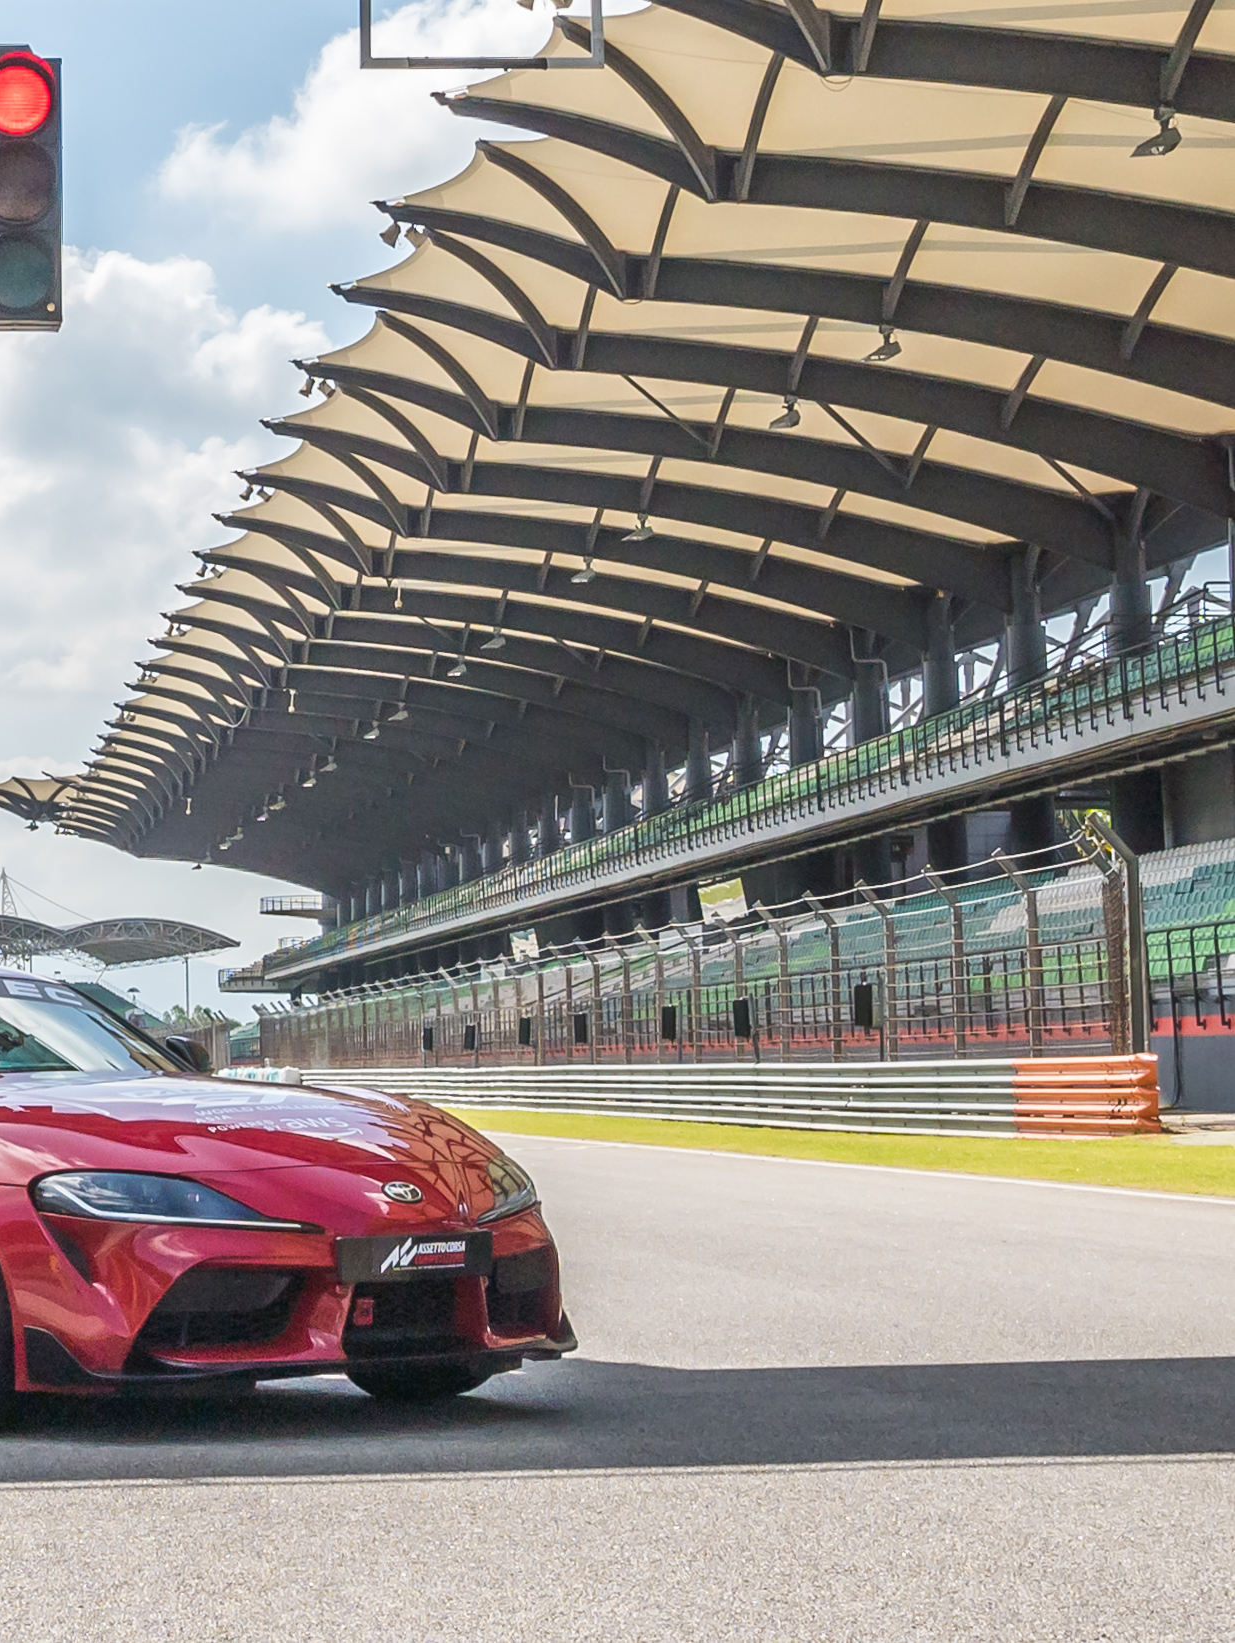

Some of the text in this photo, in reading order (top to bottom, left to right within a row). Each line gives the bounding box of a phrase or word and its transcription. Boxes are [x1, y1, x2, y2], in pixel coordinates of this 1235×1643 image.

[195, 1104, 254, 1118] WORLD
[207, 1119, 275, 1133] POWERED
[280, 1116, 349, 1129] aws
